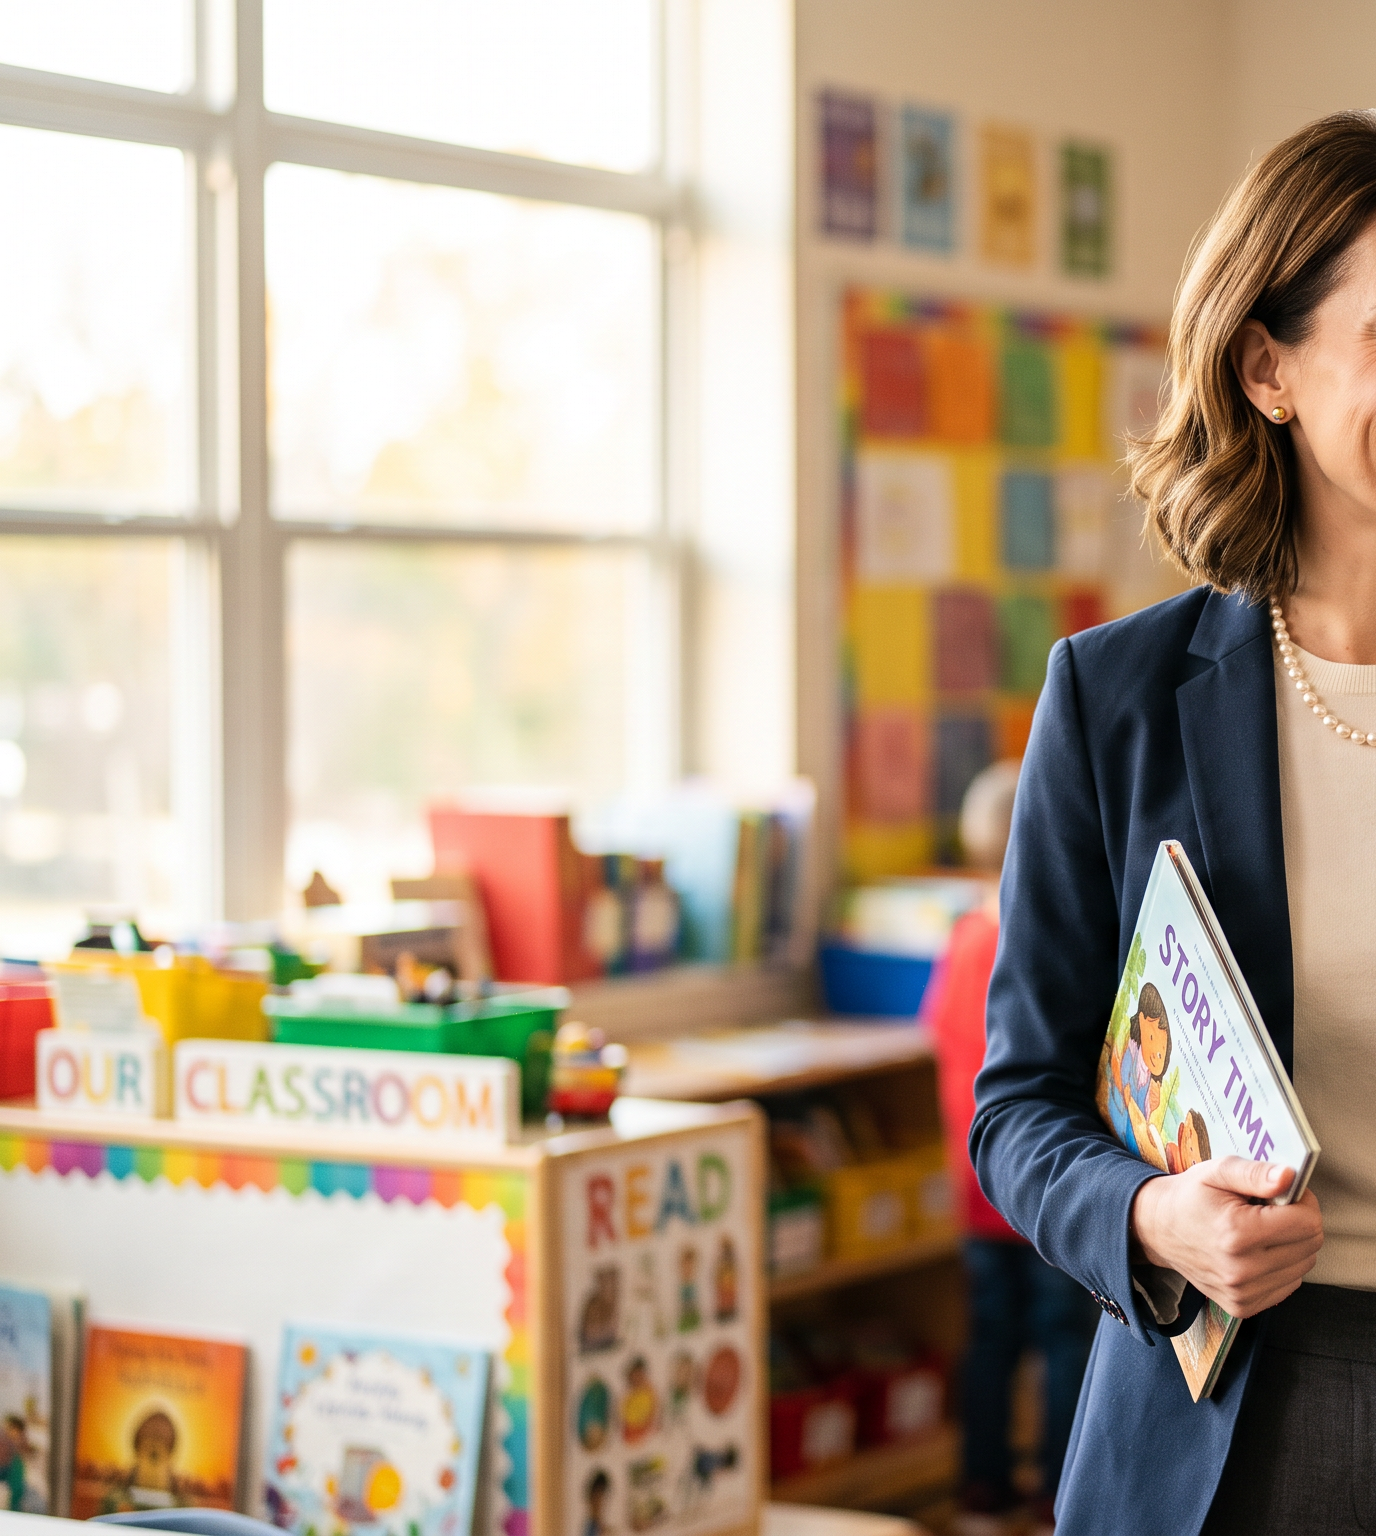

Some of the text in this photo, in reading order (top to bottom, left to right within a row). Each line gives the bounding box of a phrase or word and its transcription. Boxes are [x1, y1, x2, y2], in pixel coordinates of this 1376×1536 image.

[1158, 923, 1226, 1064] STORY
[47, 1046, 496, 1131] OUR CLASSROOM
[585, 1154, 732, 1251] READ
